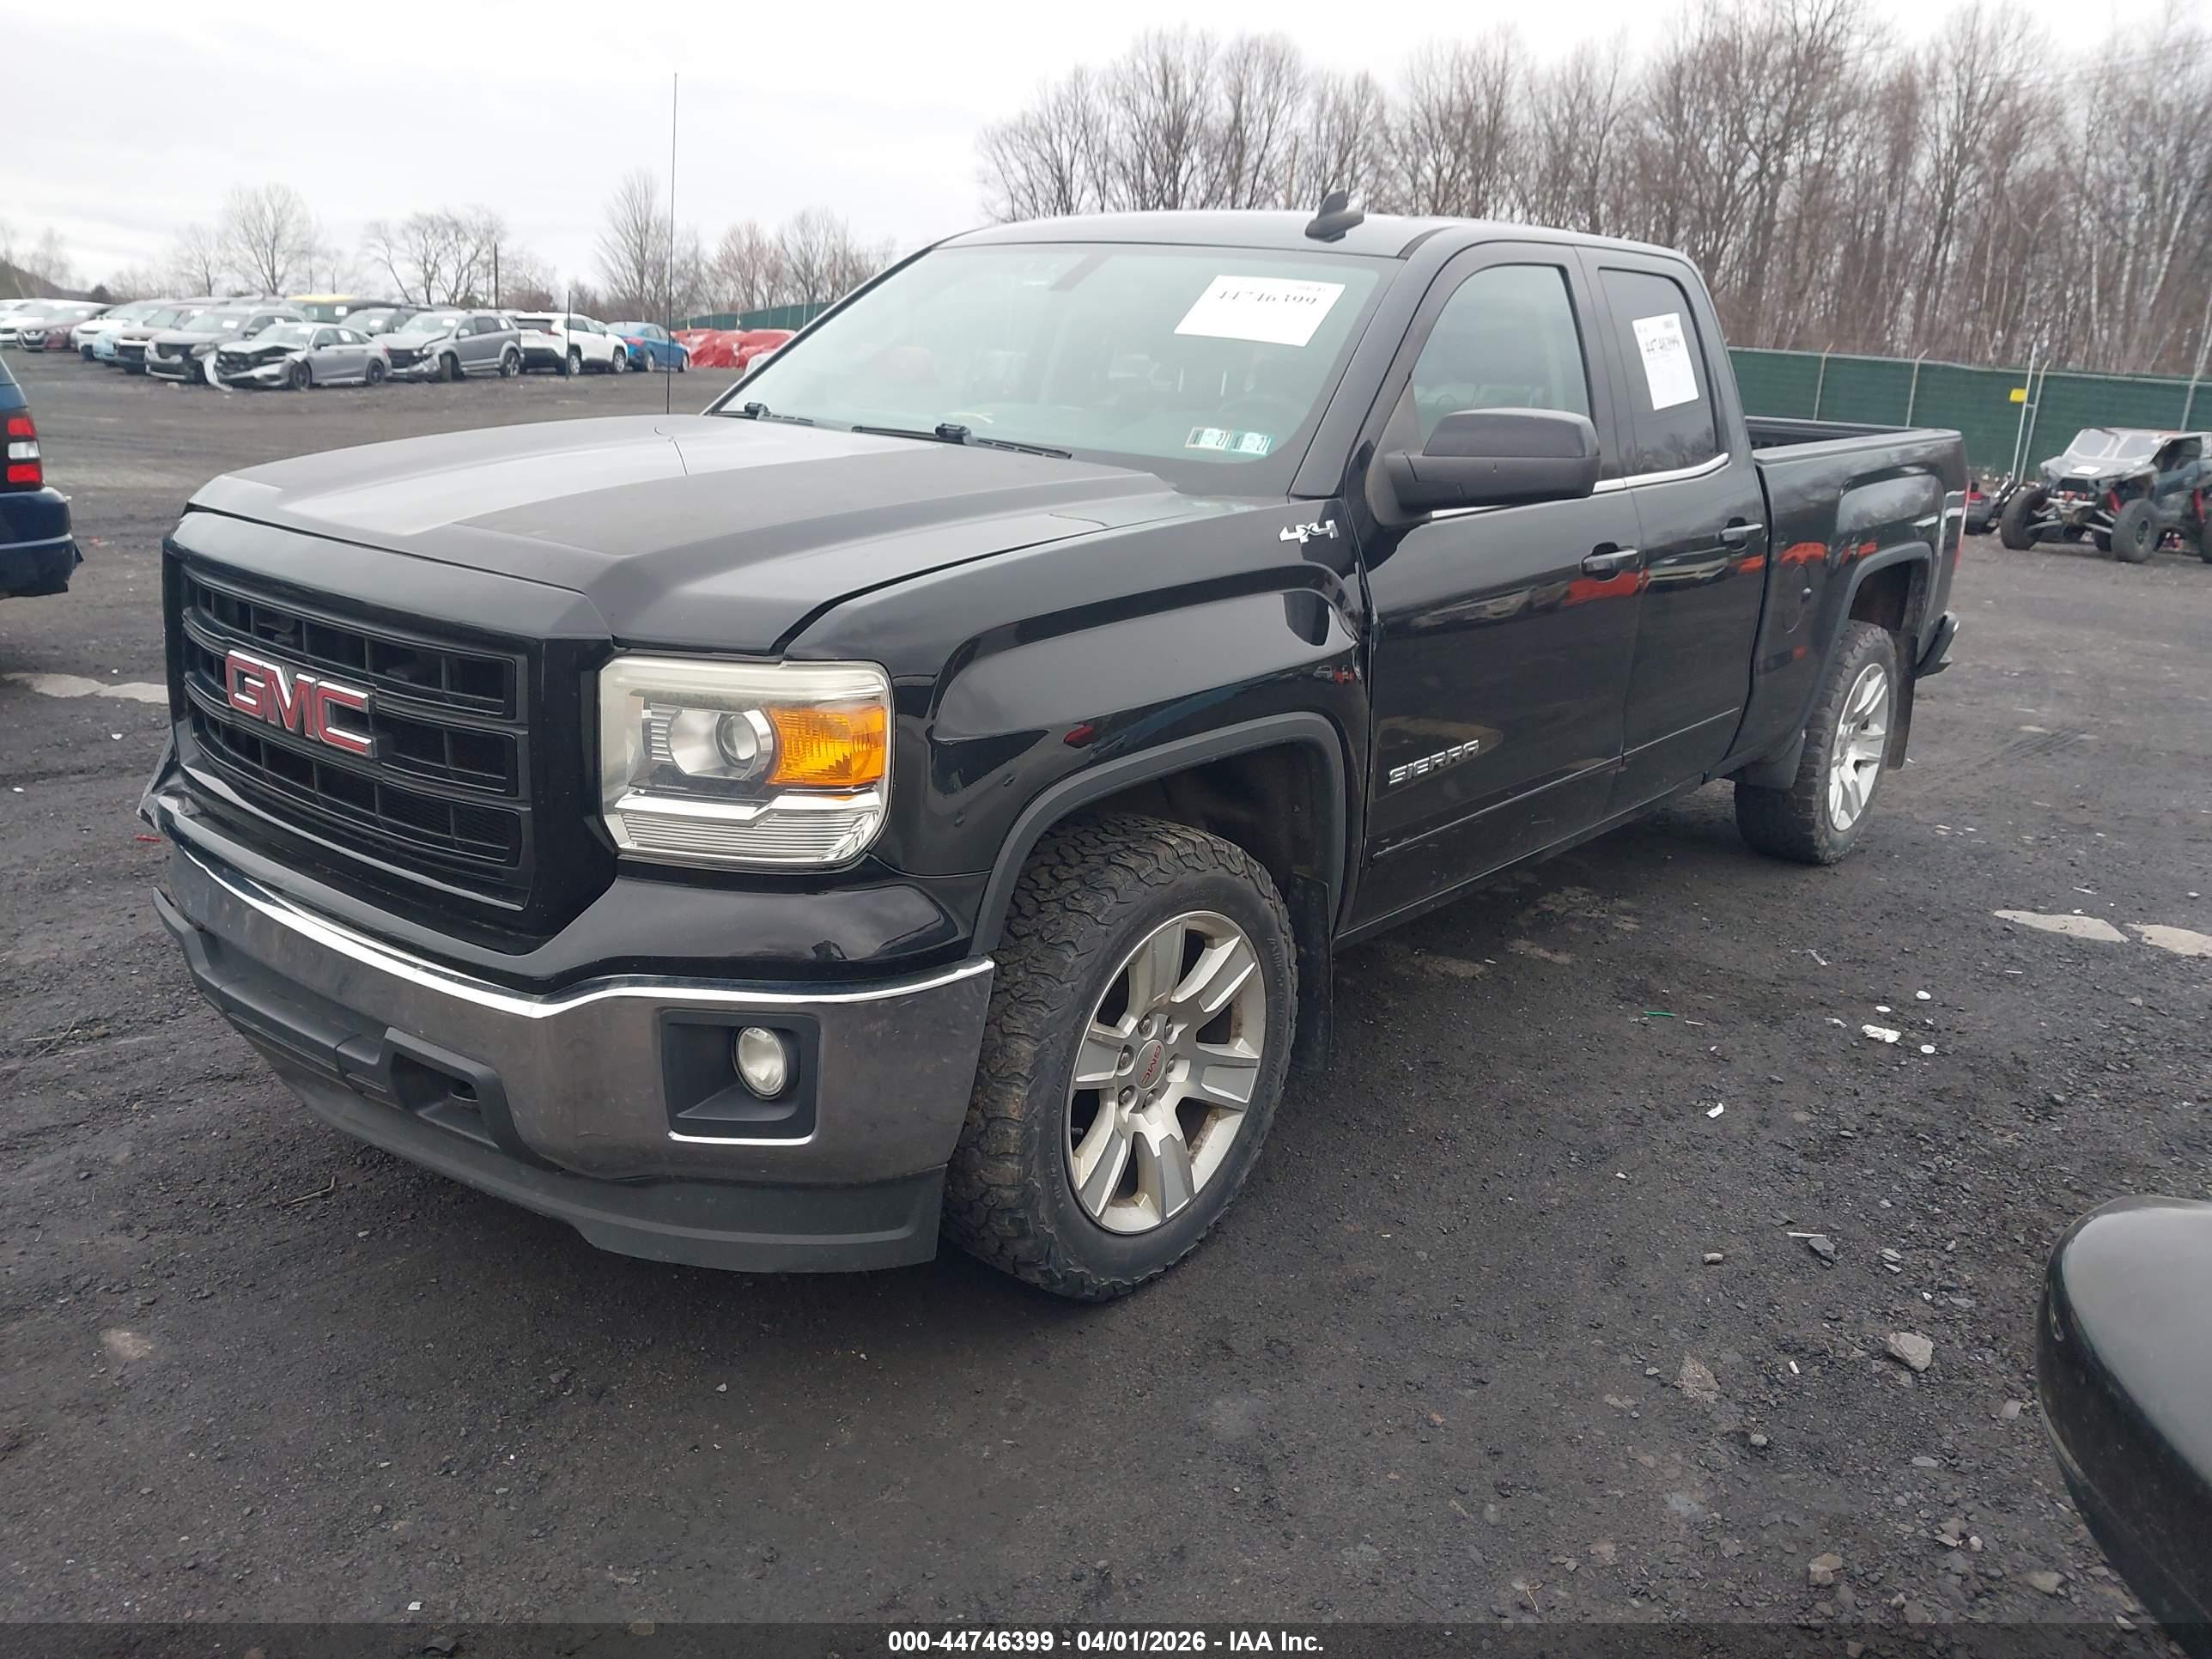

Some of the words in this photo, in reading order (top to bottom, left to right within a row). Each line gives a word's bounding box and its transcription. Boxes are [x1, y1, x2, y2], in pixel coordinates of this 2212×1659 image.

[224, 649, 376, 758] GMC
[1389, 739, 1480, 786] SIERRA
[1140, 1044, 1162, 1085] GMC
